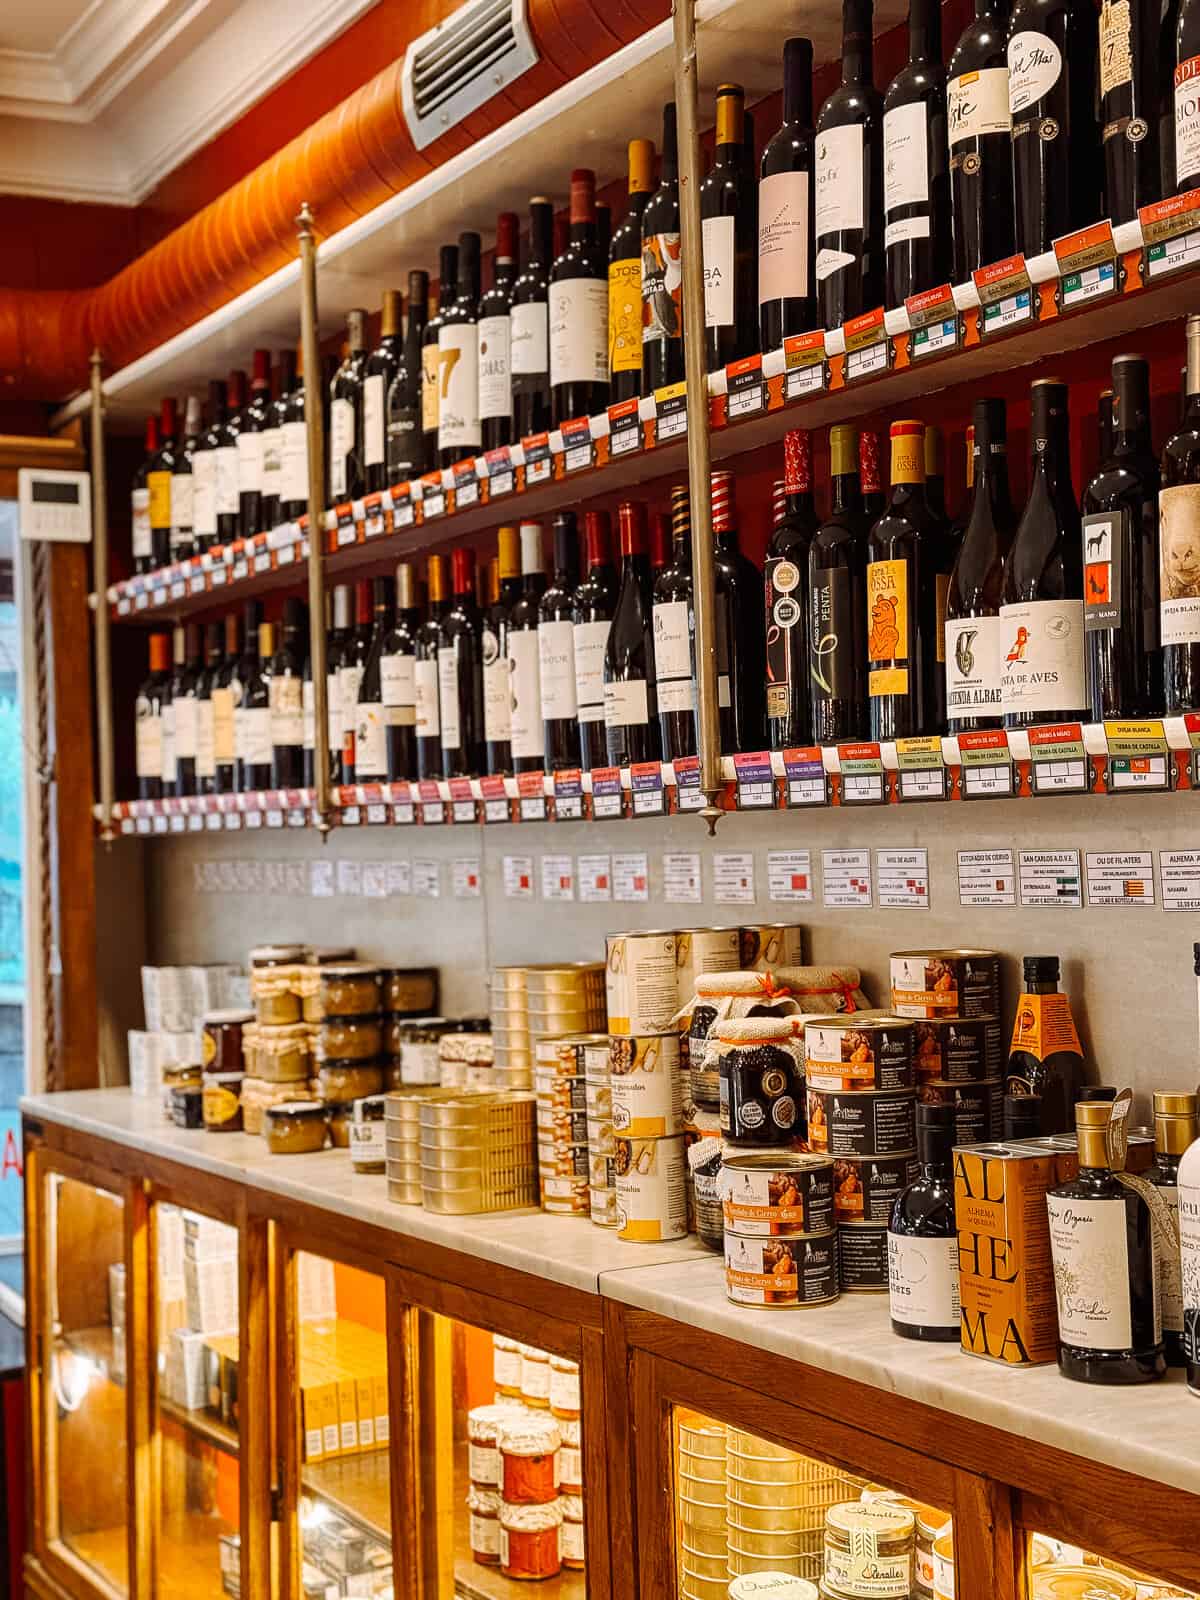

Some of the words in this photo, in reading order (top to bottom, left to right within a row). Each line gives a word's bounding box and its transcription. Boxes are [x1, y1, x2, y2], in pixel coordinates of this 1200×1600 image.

[821, 585, 831, 620] PENTA
[1016, 674, 1028, 683] DE
[1029, 671, 1059, 683] AVES
[1034, 855, 1053, 863] CARLOS
[1170, 855, 1193, 863] ALHEMA
[960, 1306, 1032, 1364] MA
